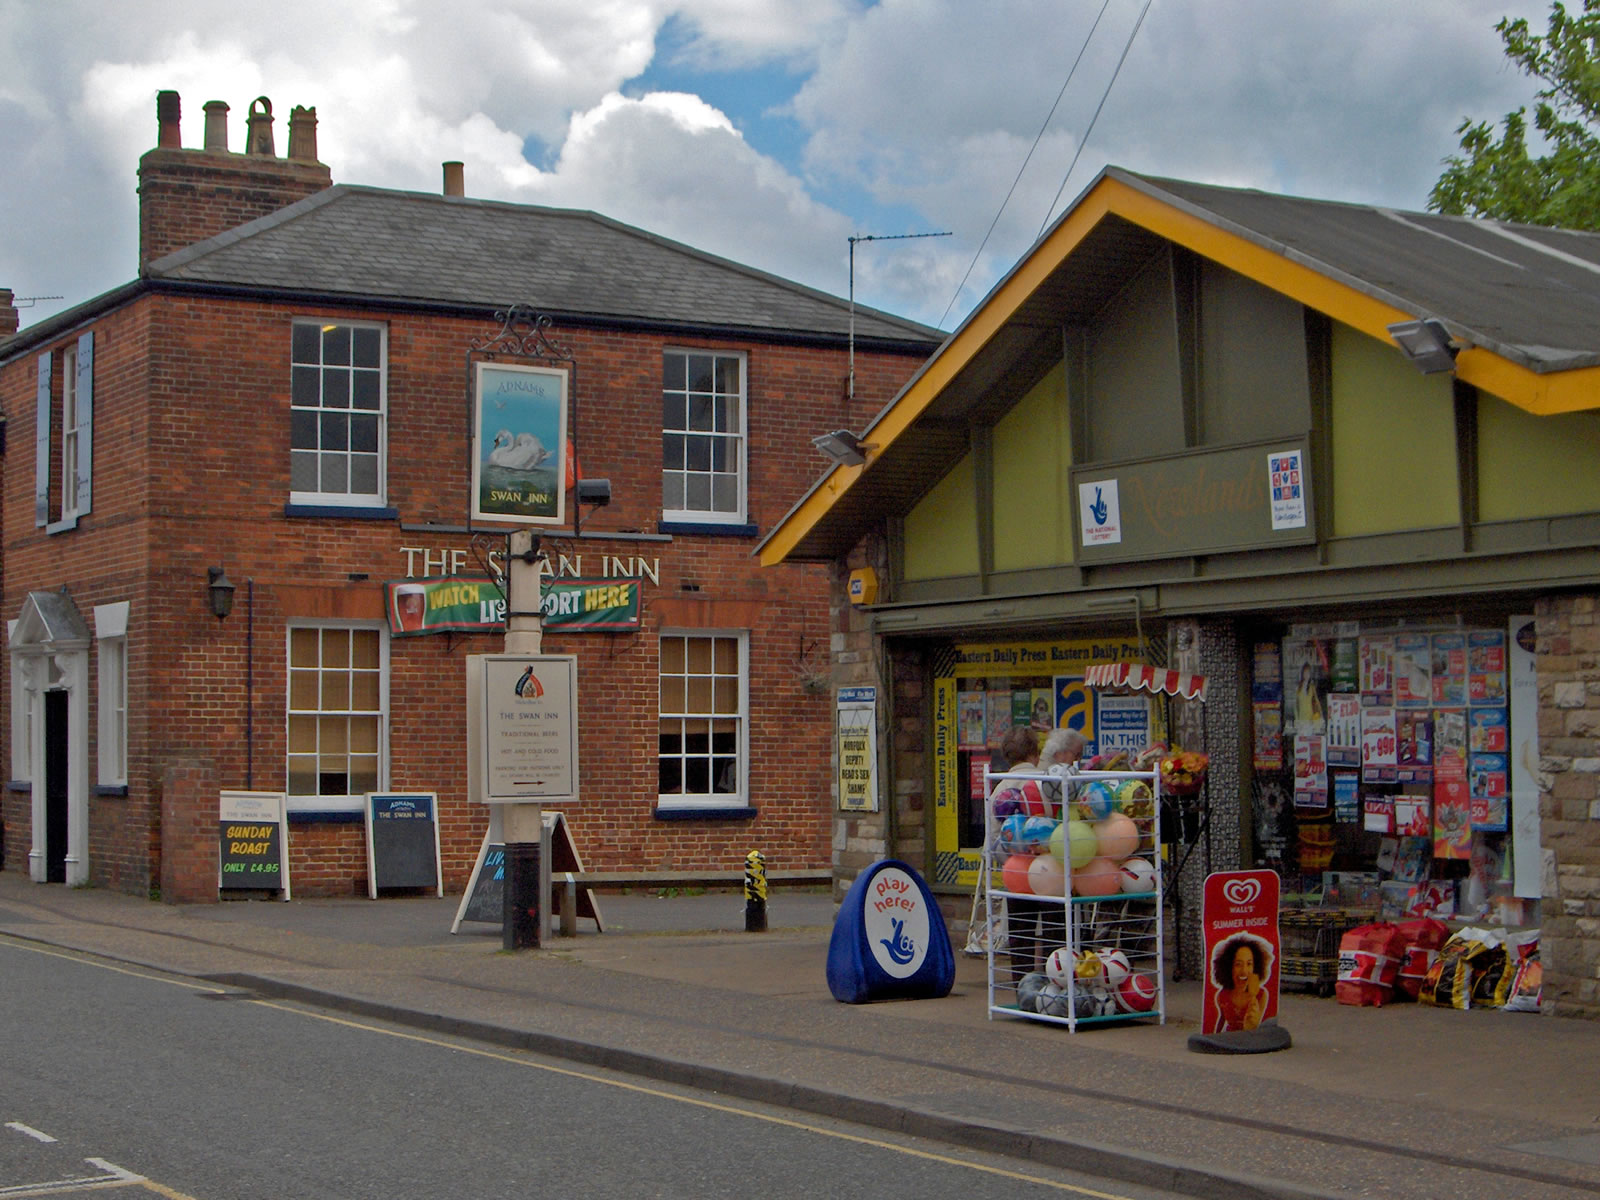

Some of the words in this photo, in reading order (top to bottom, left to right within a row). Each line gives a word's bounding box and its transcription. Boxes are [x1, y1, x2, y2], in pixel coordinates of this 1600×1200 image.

[497, 380, 545, 397] ADNAMS
[491, 490, 521, 502] SWAN
[528, 493, 548, 504] INN
[400, 547, 467, 578] THE
[488, 551, 582, 584] SAN
[602, 554, 660, 587] INN
[429, 585, 480, 610] WATCH
[479, 600, 507, 624] LIV
[584, 583, 630, 613] HERE
[955, 648, 991, 664] Eastern
[993, 647, 1018, 664] Daily
[1020, 647, 1047, 661] Press
[1051, 646, 1090, 660] Eastern
[1092, 644, 1118, 661] Daily
[1120, 644, 1146, 657] Pres
[937, 687, 945, 721] Press
[500, 712, 515, 720] THE
[519, 712, 540, 720] SWAN
[544, 712, 559, 720] INN
[843, 740, 866, 751] NORFOLK
[937, 724, 948, 757] Daily
[1102, 733, 1115, 746] IN
[1118, 733, 1148, 746] THIS
[846, 755, 864, 766] DEPUTY
[847, 783, 865, 794] SHAME
[938, 758, 946, 808] Eastern
[378, 811, 391, 819] THE
[393, 811, 413, 819] SWAN
[414, 811, 427, 819] INN
[226, 826, 273, 839] SUNDAY
[230, 842, 271, 855] ROAST
[484, 851, 504, 867] LIV
[223, 863, 246, 873] ONLY
[876, 877, 910, 897] play
[874, 896, 916, 913] here!
[1212, 918, 1245, 930] SUMMER
[1245, 917, 1269, 927] INSIDE
